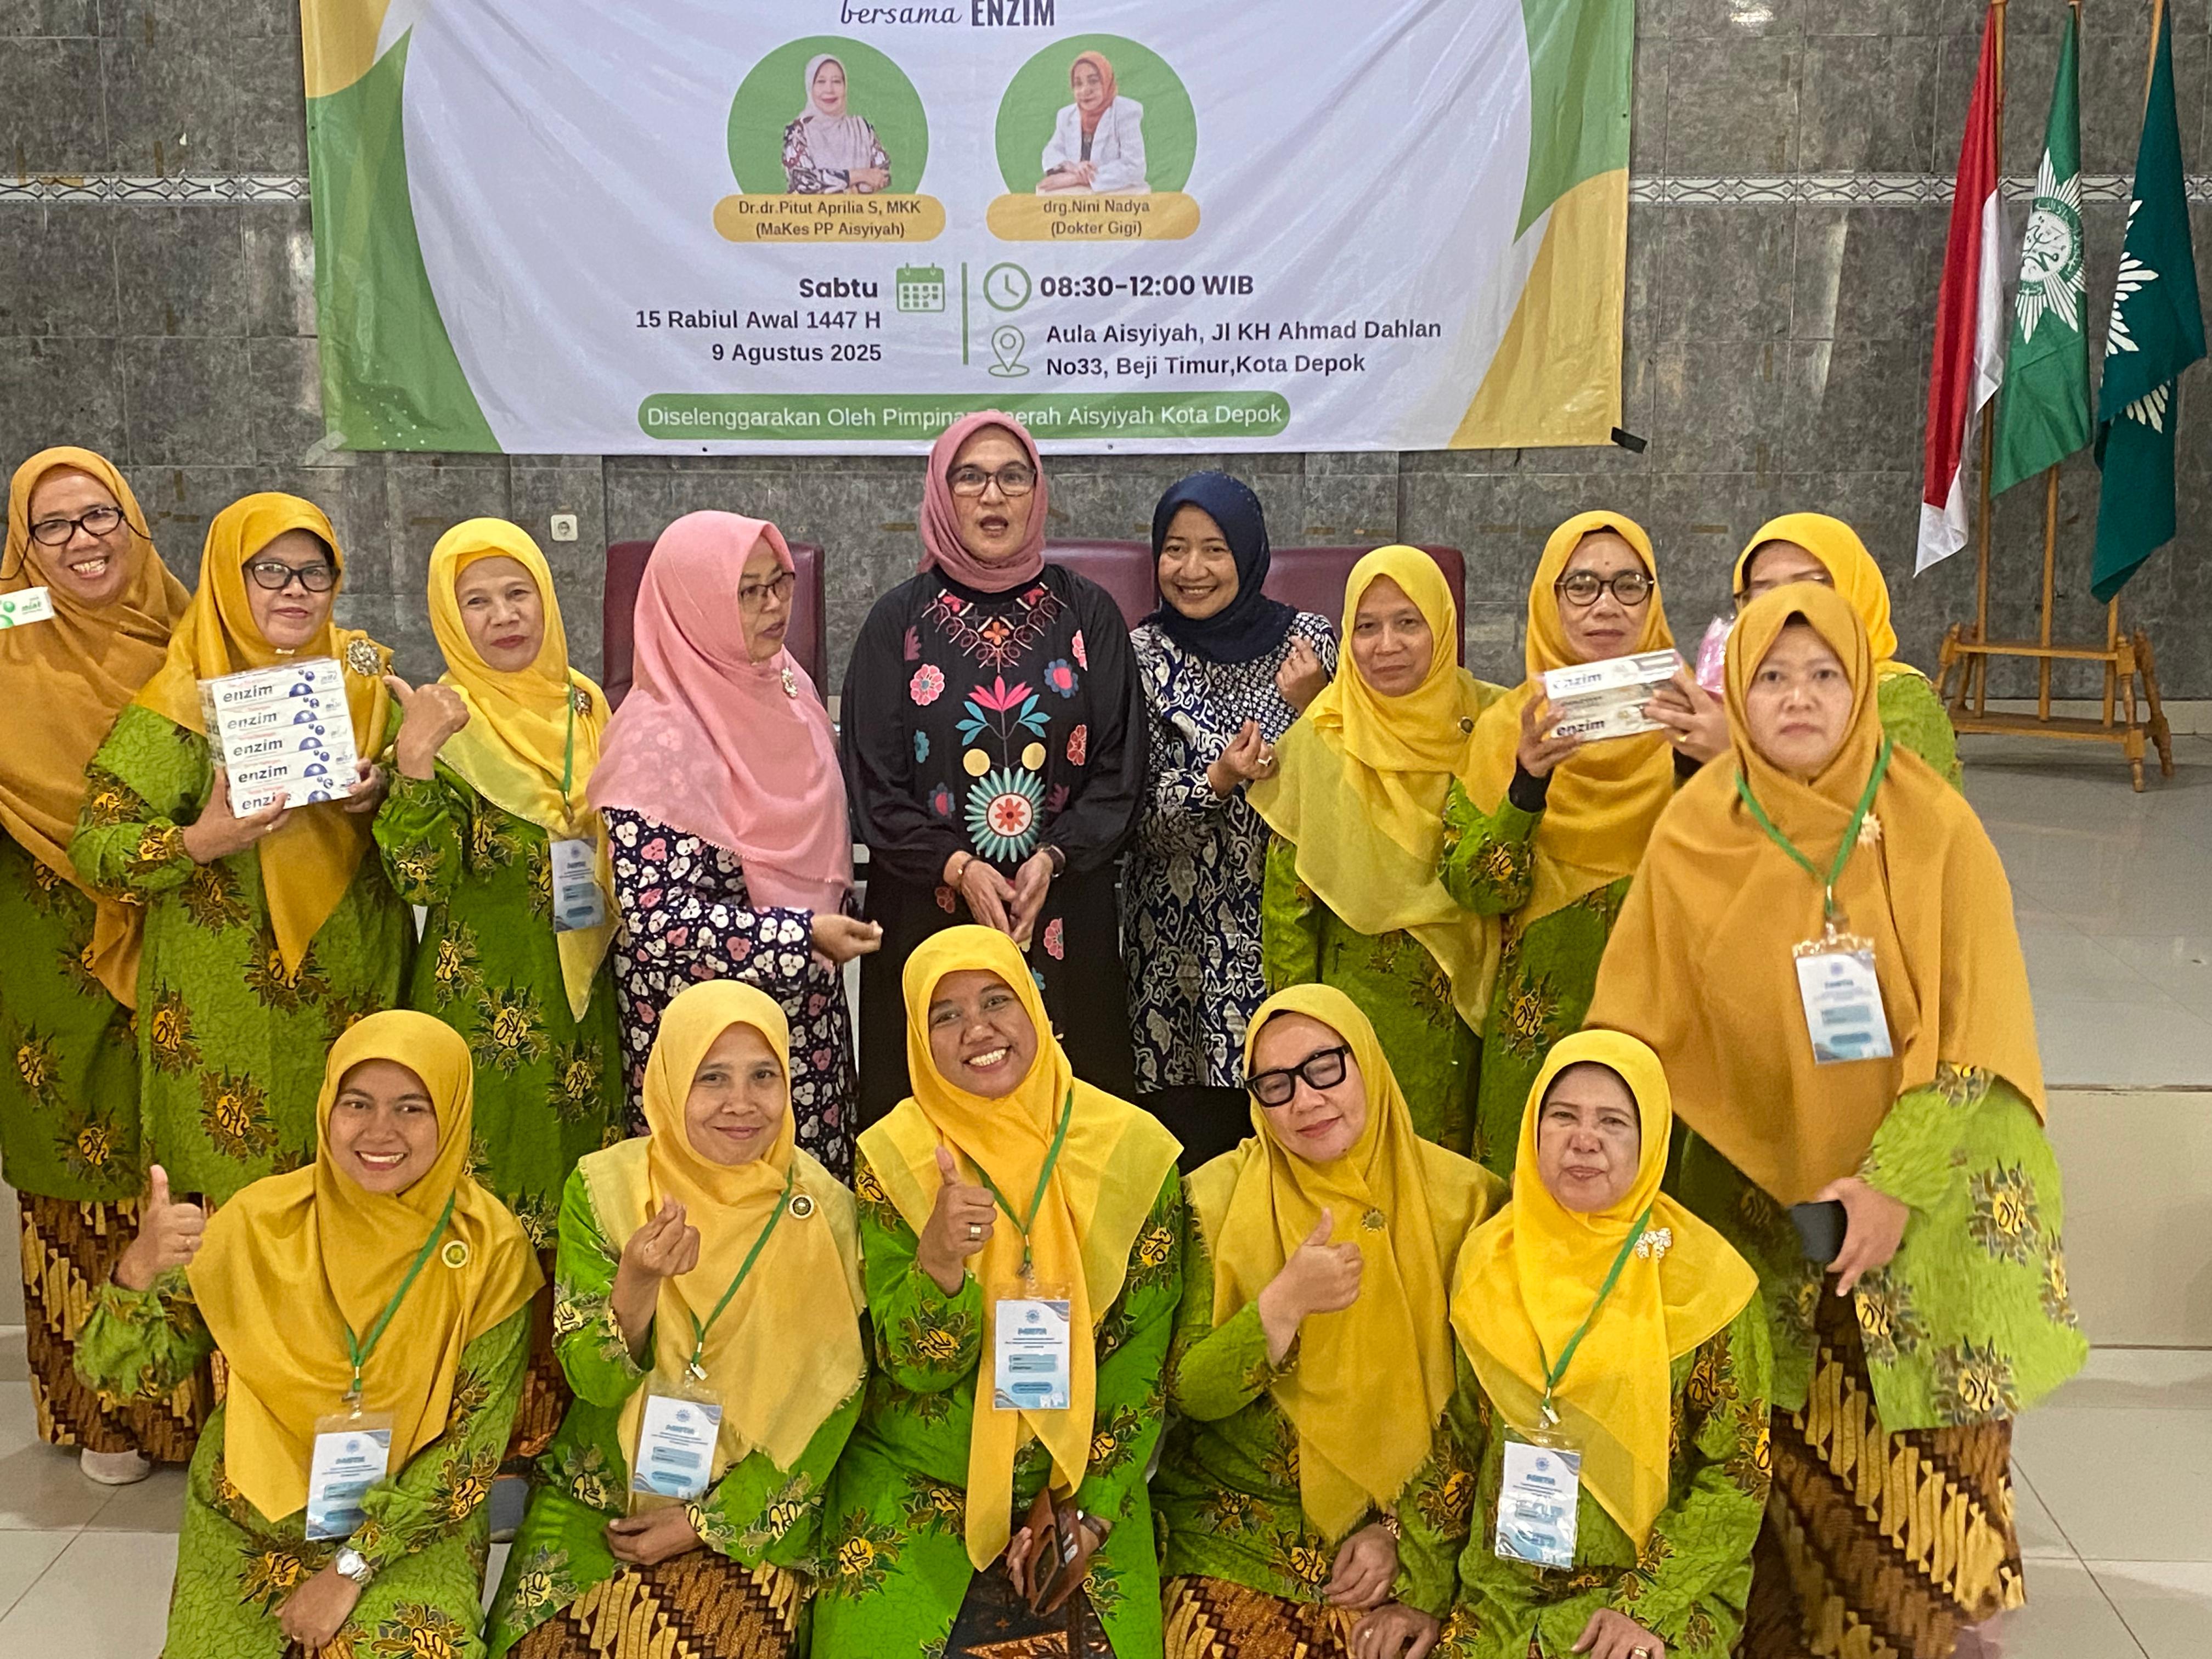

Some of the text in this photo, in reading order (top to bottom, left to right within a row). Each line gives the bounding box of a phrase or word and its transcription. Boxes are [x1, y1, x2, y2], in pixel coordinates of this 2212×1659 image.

[840, 0, 1054, 26] bersama ENZIM
[738, 200, 921, 217] Dr.dr.Pitut Aprilia S, MKK
[1043, 200, 1150, 216] drg.Nini Nadya
[756, 221, 905, 238] (MaKes PP Aisyiyah)
[1051, 221, 1142, 237] (Dokter Gigi)
[799, 277, 878, 298] Sabtu
[1202, 275, 1254, 295] WIB
[636, 309, 881, 329] 15 Rabiul Awal 1447 H
[1046, 319, 1442, 347] Aula Aisyiyah, Jl KH Ahmad Dahlan
[712, 343, 882, 365] 9 Agustus 2025
[1047, 353, 1366, 379] No33, Beji Timur,Kota Depok
[647, 407, 821, 430] Diselenggarakan
[827, 408, 876, 426] Oleh
[1068, 405, 1153, 428] Aisyiyah
[1161, 406, 1209, 424] Kota
[1215, 404, 1282, 427] Depok
[223, 684, 273, 702] enzim
[227, 712, 277, 730] enzim
[233, 738, 283, 757] enzim
[238, 765, 288, 783] enzim
[242, 792, 291, 810] enzi
